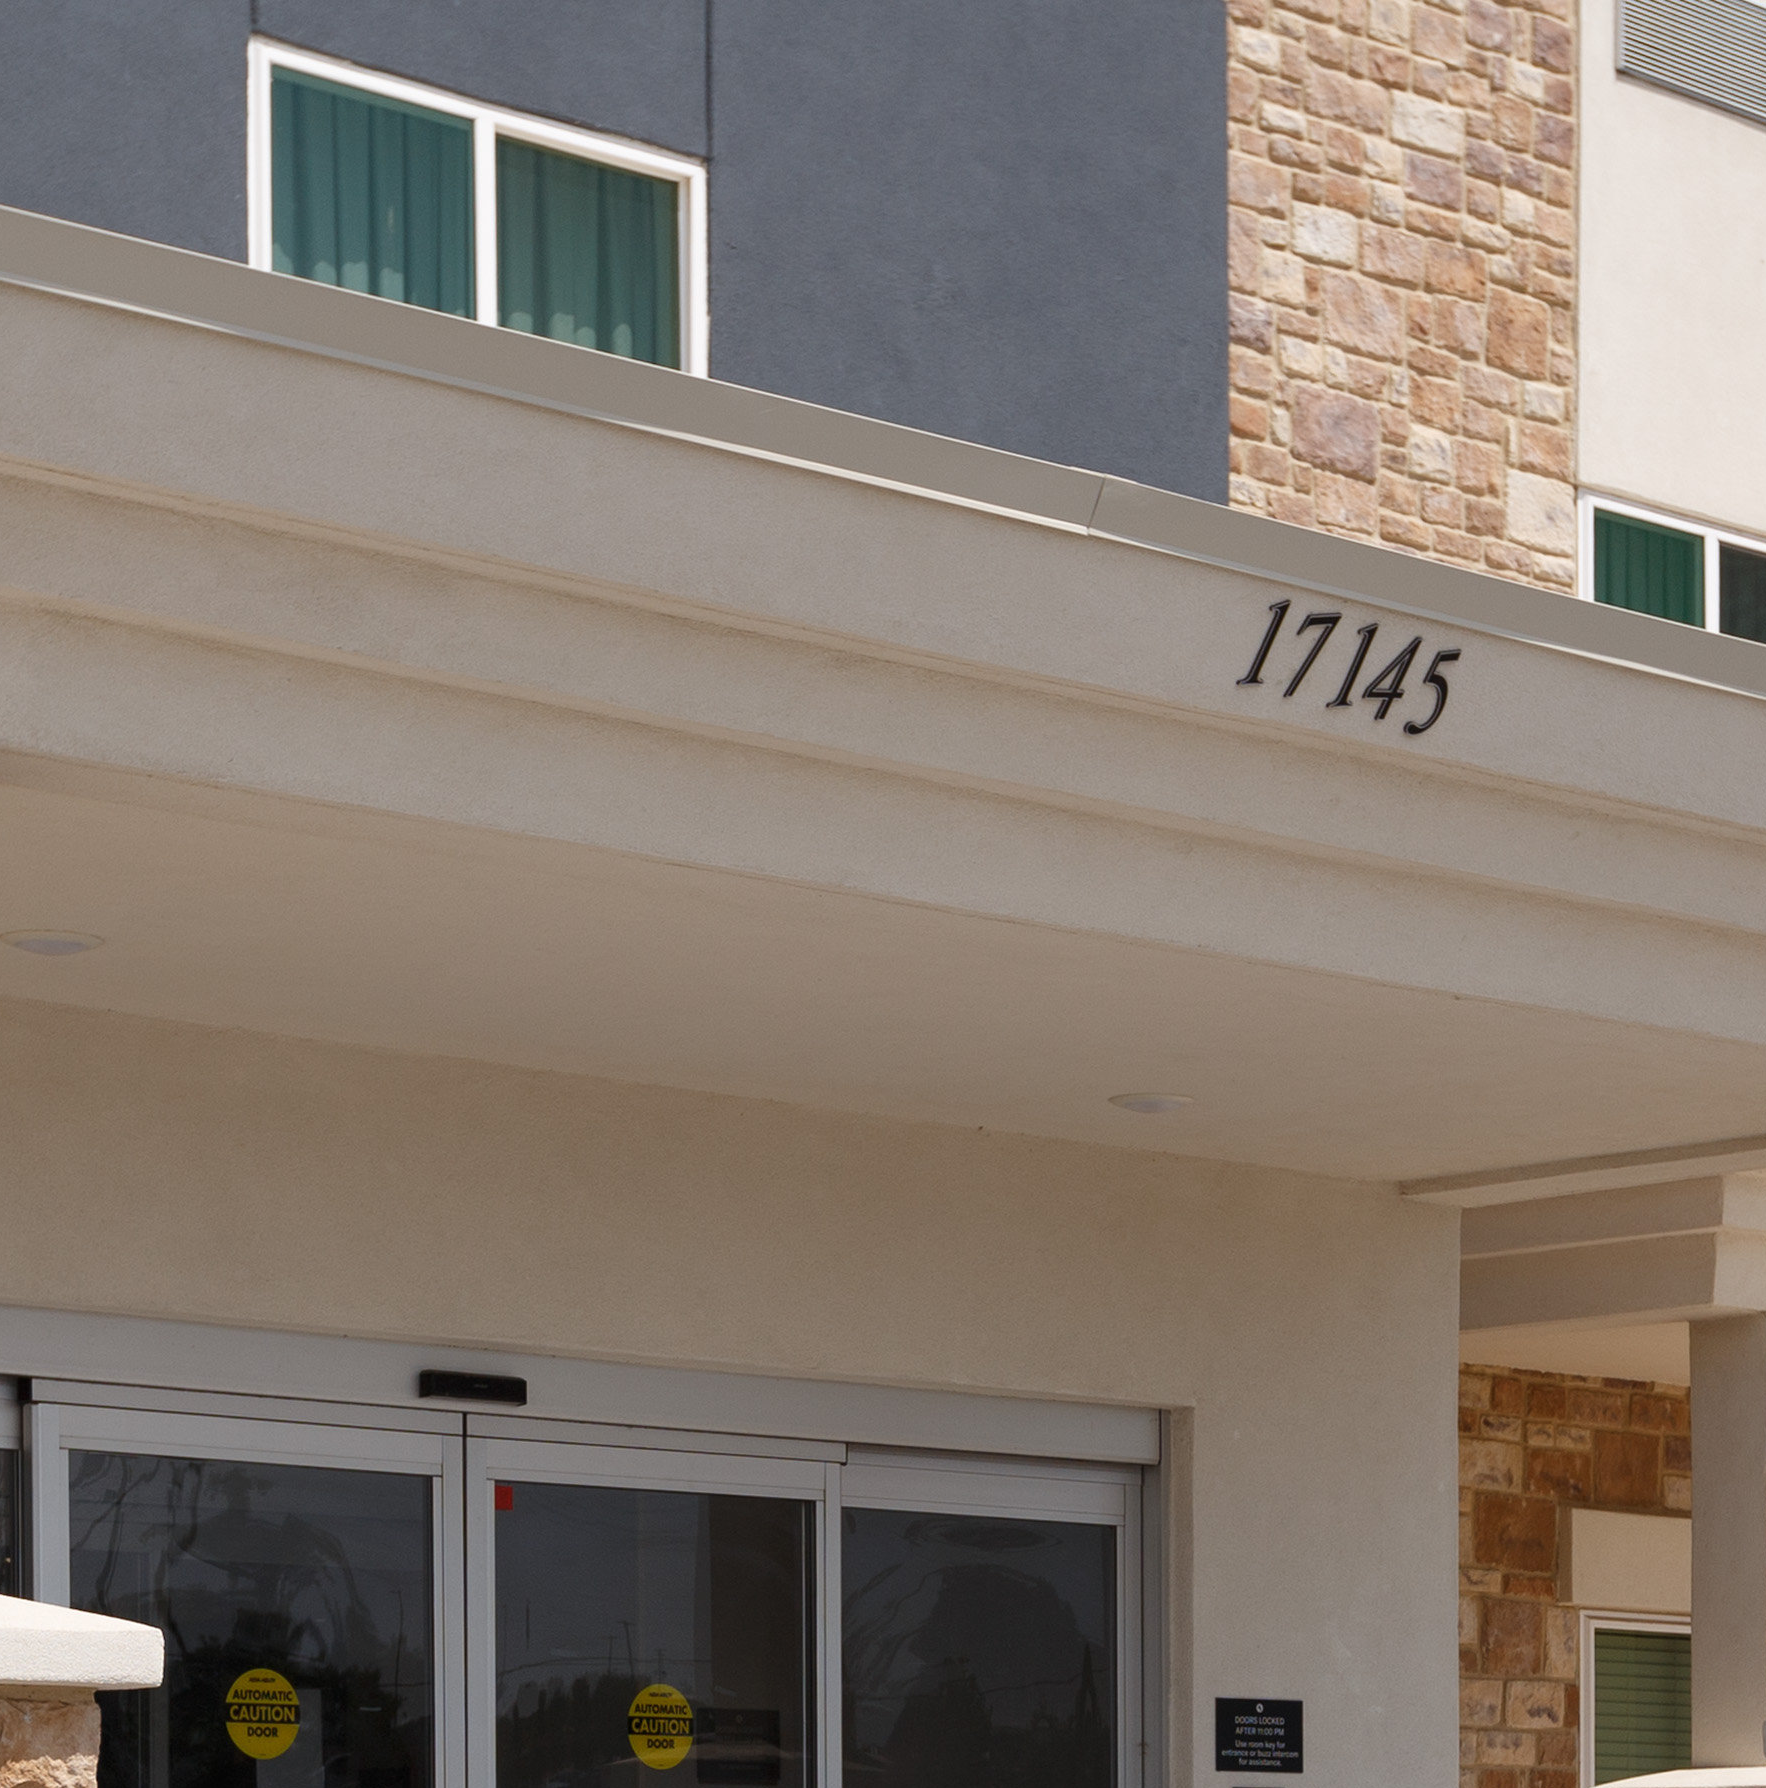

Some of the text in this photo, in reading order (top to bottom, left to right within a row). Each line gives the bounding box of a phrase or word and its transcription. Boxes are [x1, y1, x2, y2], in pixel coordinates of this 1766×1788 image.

[1236, 599, 1462, 735] 17145
[233, 1689, 293, 1701] AUTOMATIC
[229, 1705, 296, 1722] CAUTION
[634, 1703, 687, 1715] AUTOMATIC
[631, 1718, 690, 1734] CAUTION
[1234, 1715, 1285, 1726] DOORS LOCKED
[247, 1726, 278, 1738] DOOR
[1235, 1726, 1256, 1735] AFTER
[1274, 1727, 1285, 1736] PM
[647, 1739, 675, 1749] DOOR
